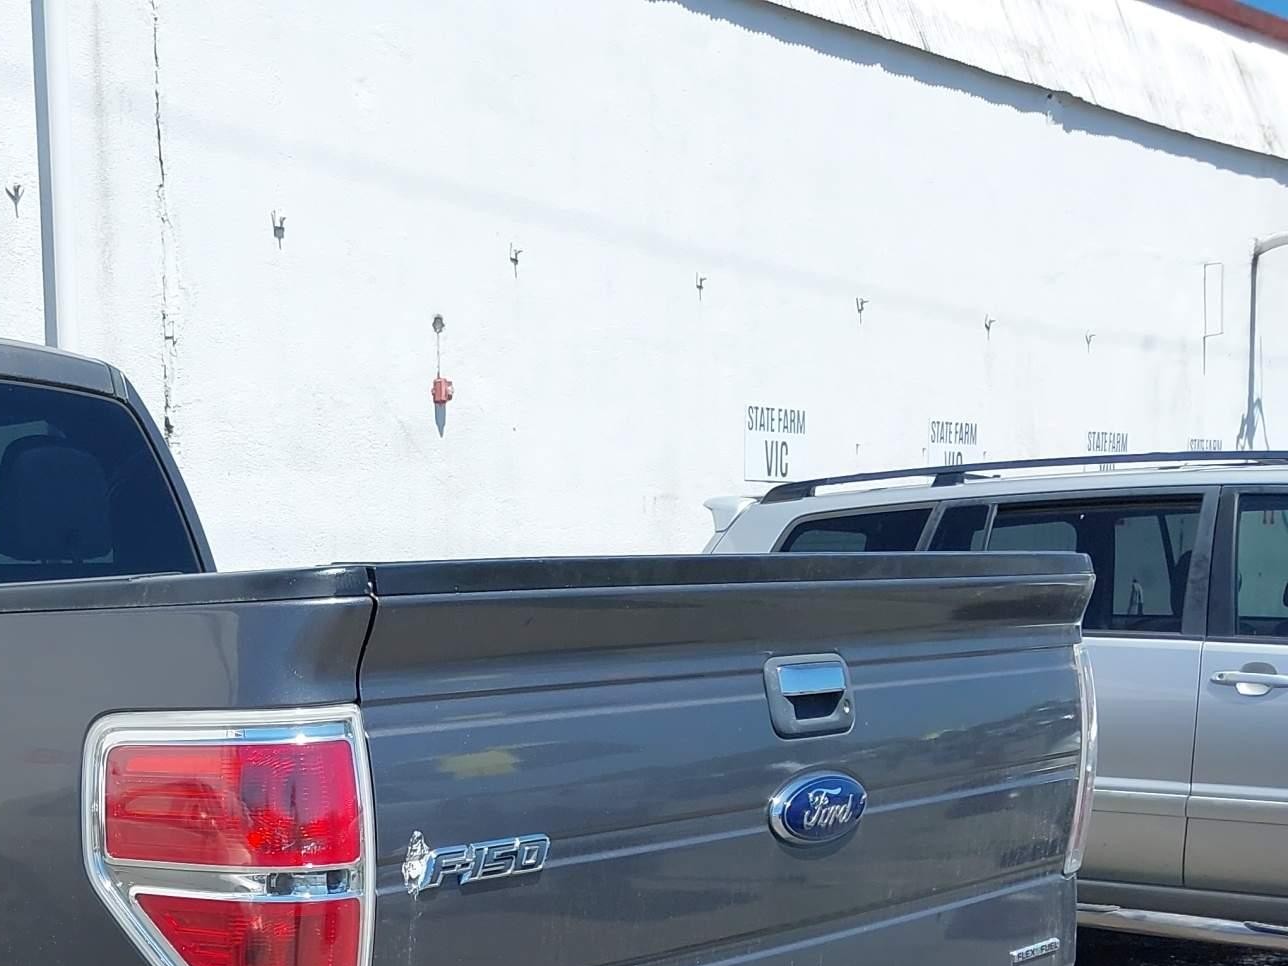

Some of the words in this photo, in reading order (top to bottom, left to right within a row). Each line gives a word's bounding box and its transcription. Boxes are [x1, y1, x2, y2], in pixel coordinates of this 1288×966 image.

[747, 405, 775, 432] STATE
[778, 408, 806, 435] FARM
[931, 420, 953, 444] STATE
[954, 422, 977, 446] FARM
[765, 439, 789, 478] VIC
[803, 787, 854, 831] Ford
[418, 833, 551, 892] F-150
